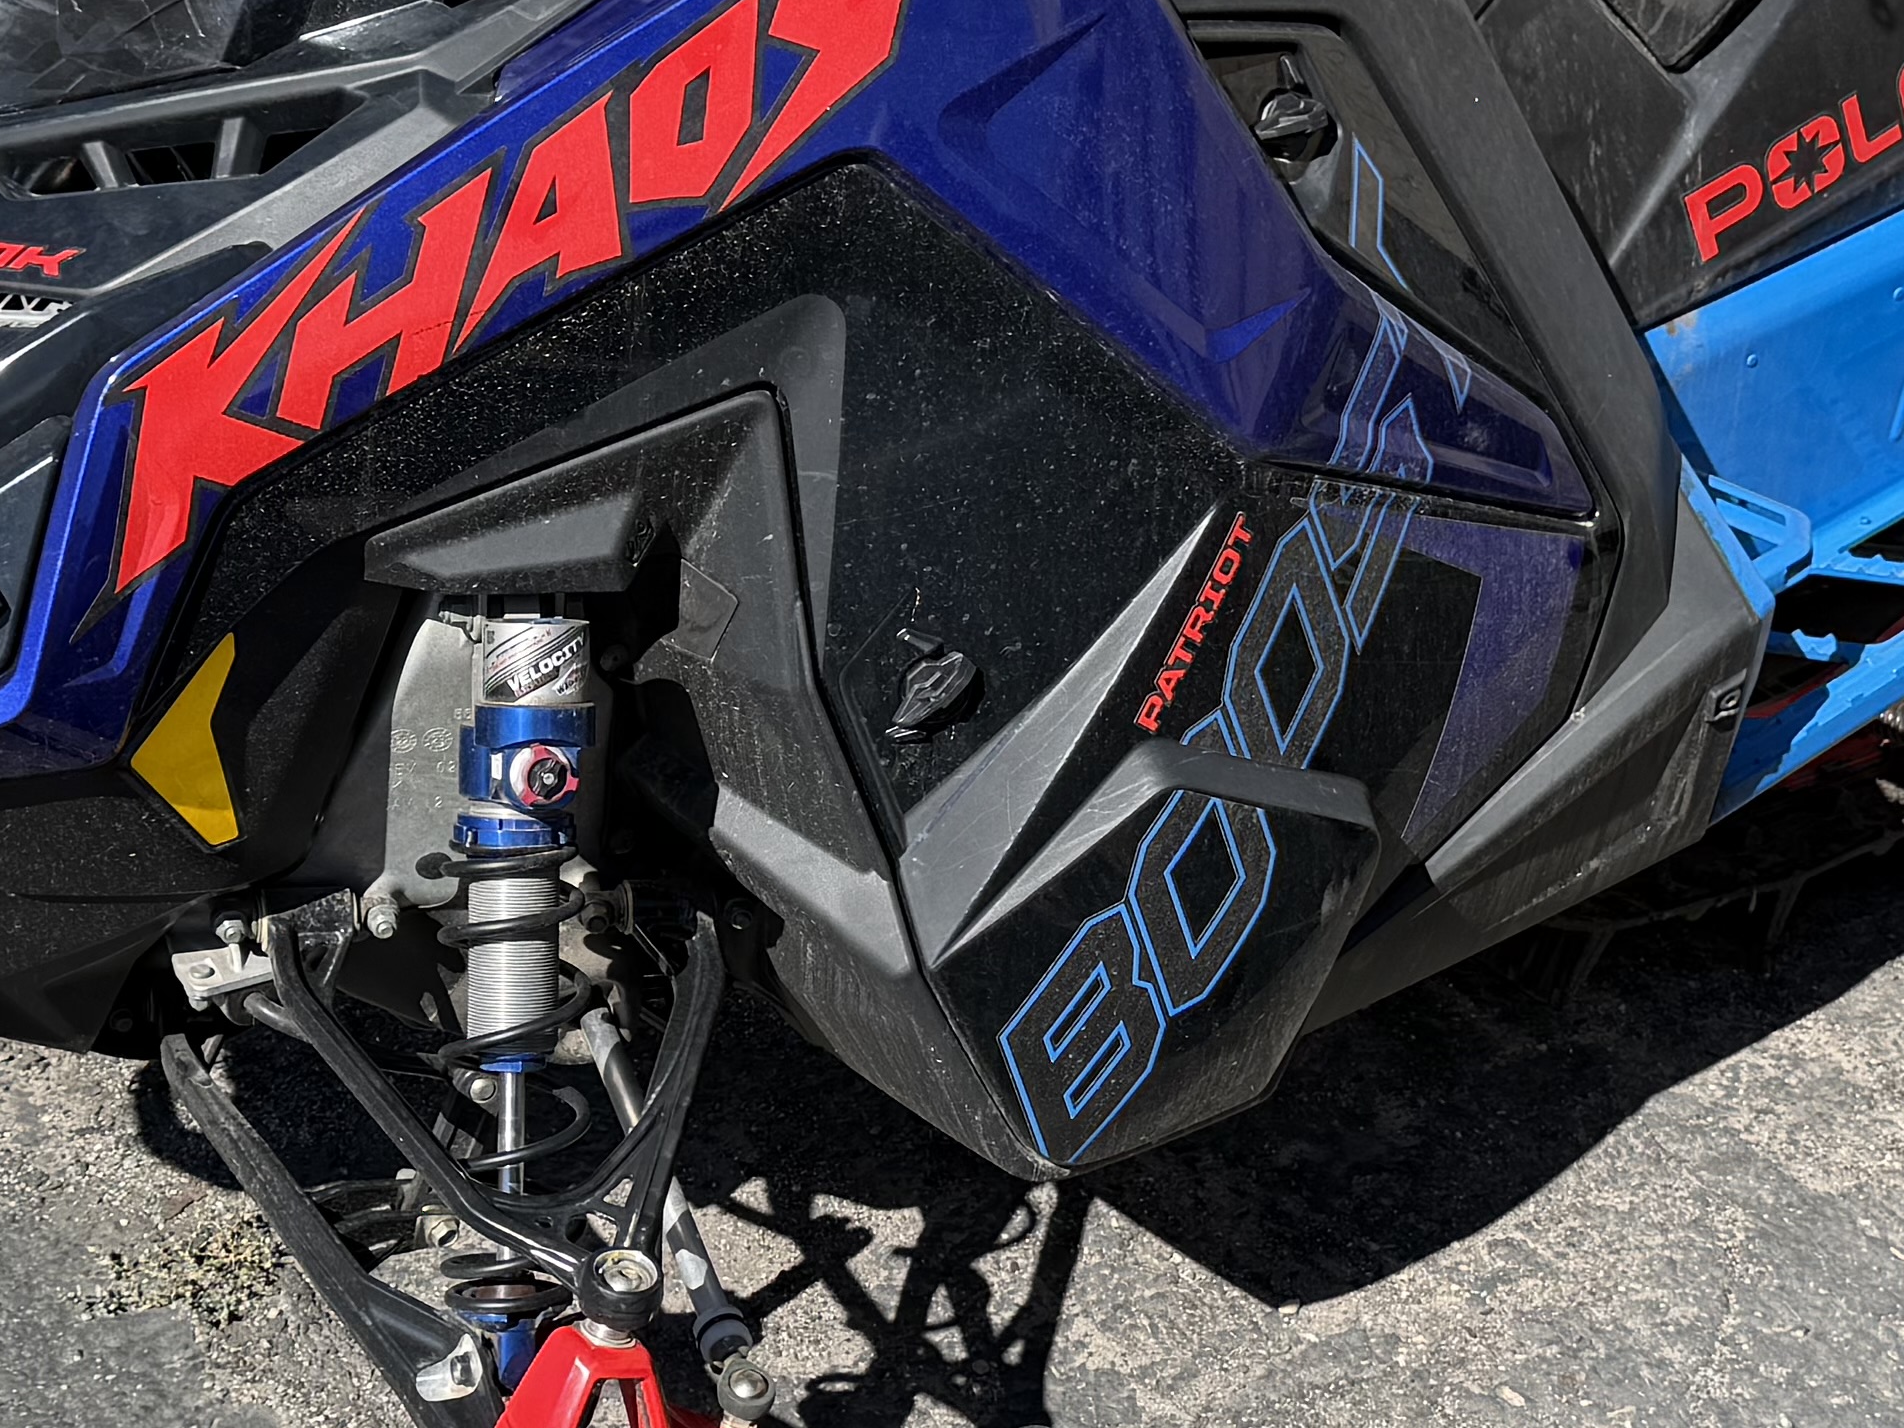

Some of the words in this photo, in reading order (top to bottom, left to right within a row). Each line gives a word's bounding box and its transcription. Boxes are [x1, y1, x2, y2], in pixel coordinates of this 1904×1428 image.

[507, 632, 585, 692] VELOCITY
[998, 134, 1470, 1163] BOOST
[1132, 511, 1253, 734] PATRIOT
